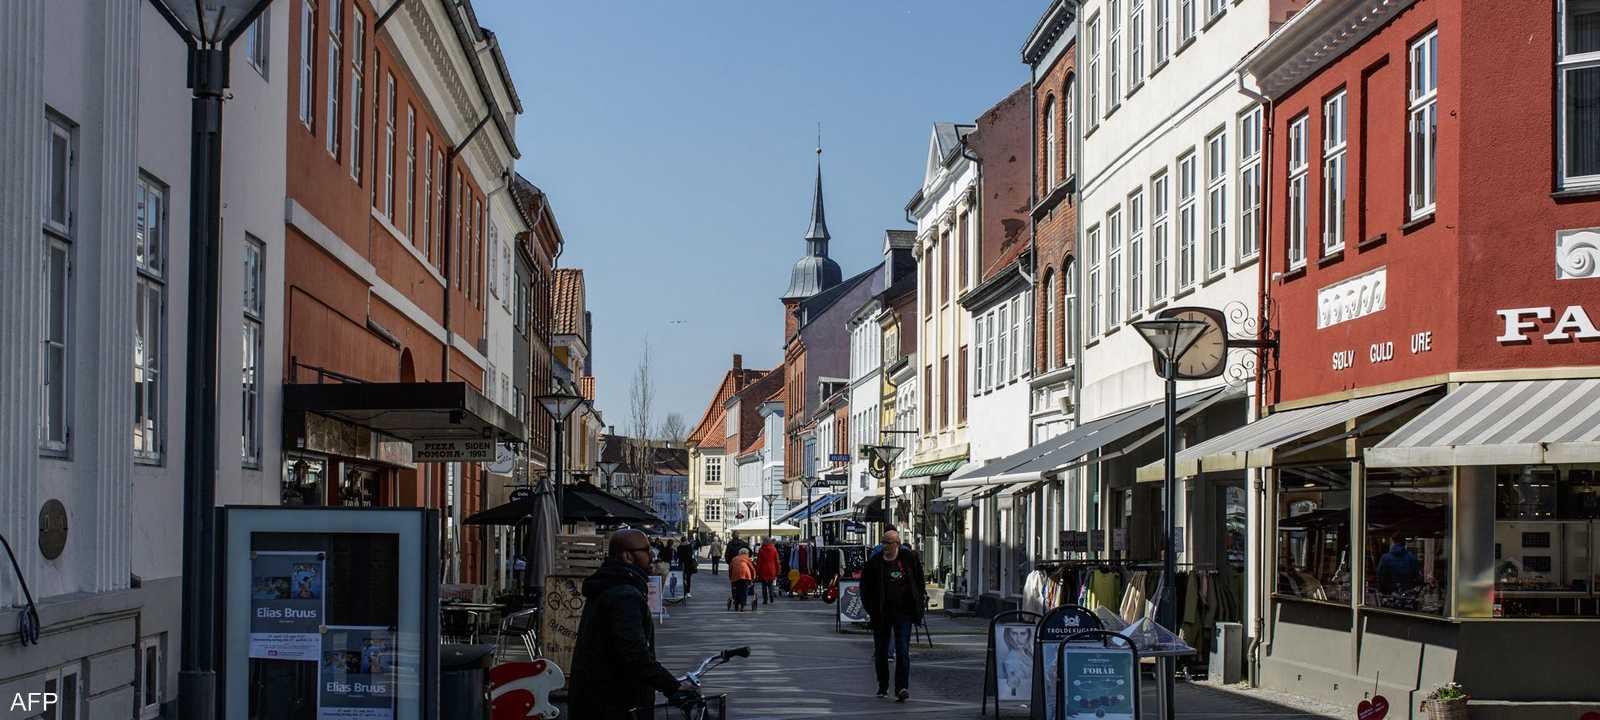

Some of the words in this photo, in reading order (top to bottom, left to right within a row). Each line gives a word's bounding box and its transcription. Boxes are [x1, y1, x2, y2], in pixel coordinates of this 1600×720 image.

[1496, 305, 1600, 343] FA
[1332, 349, 1355, 371] SØLV
[1370, 342, 1394, 363] GULD
[1411, 331, 1433, 354] URE
[424, 442, 455, 450] PIZZA
[469, 450, 487, 458] 1993
[256, 608, 282, 618] Elias
[285, 608, 317, 618] Bruus
[326, 681, 351, 693] Elias
[354, 682, 386, 694] Bruus
